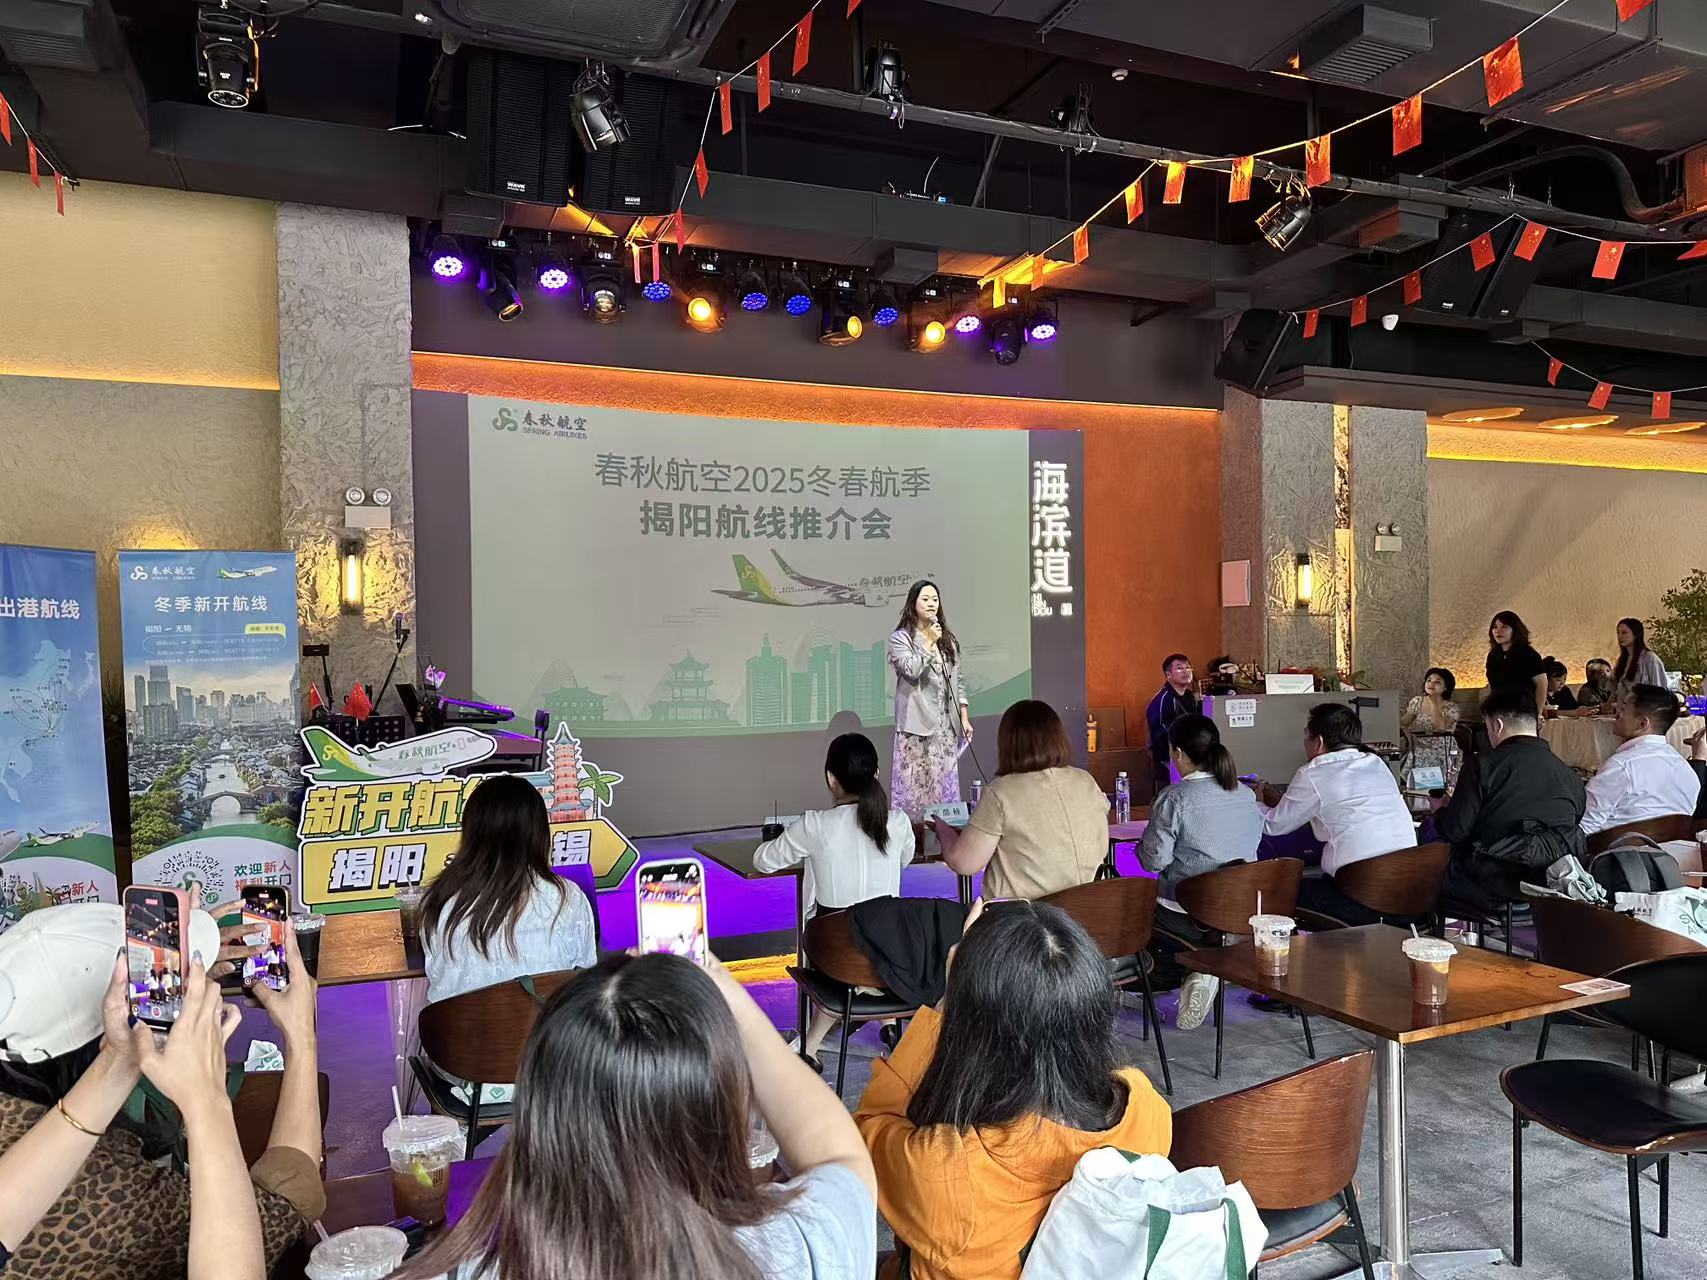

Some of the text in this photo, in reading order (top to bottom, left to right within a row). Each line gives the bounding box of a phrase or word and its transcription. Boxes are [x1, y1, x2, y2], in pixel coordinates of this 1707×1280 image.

[521, 409, 587, 431] 春秋航空
[522, 426, 587, 439] SPRING AIRLINES
[594, 452, 931, 498] 春秋航空2025冬春航季
[639, 499, 892, 541] 揭阳航线推介会
[0, 596, 80, 619] 出港航线
[154, 595, 268, 613] 冬季新开航线
[302, 776, 486, 838] 新开航
[234, 860, 291, 877] 欢迎新人
[328, 844, 427, 893] 揭阳
